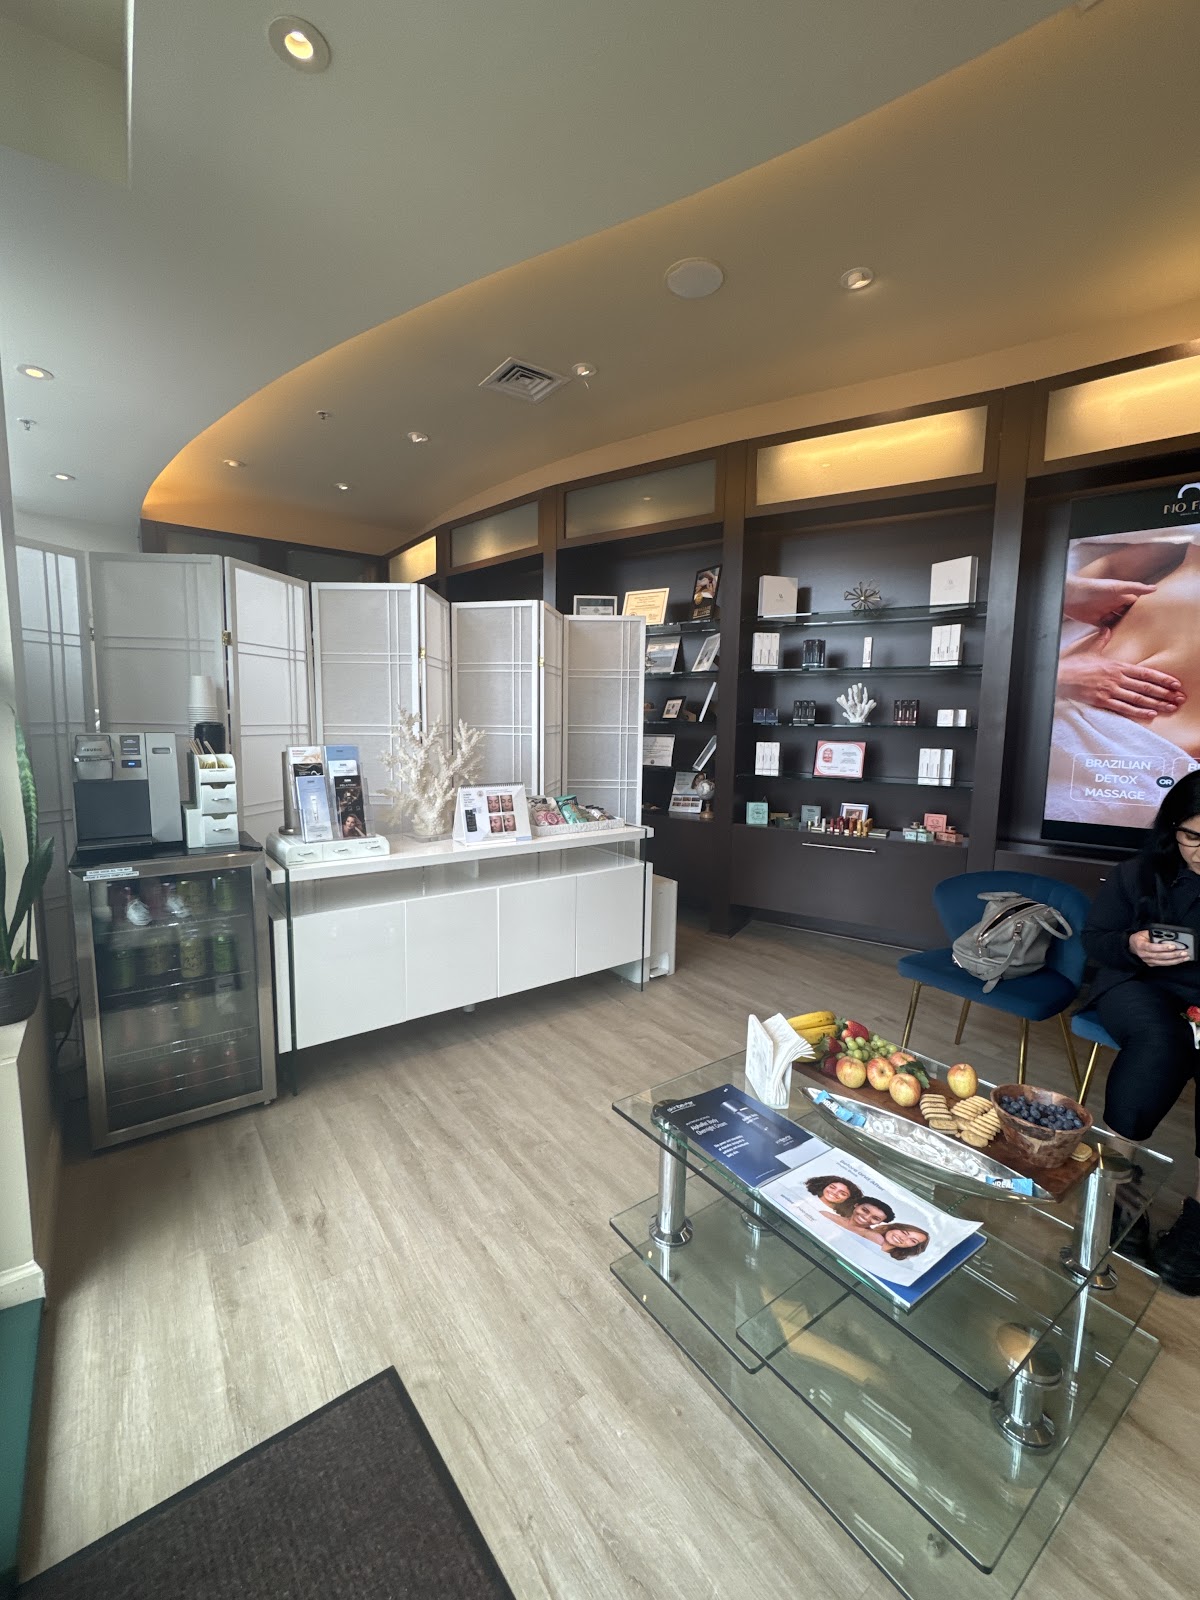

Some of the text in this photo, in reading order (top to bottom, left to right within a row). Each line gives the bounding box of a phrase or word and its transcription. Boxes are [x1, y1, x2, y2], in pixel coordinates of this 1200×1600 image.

[1163, 502, 1187, 514] NO
[1191, 500, 1200, 511] F
[1085, 759, 1151, 770] BRAZILIAN
[1095, 773, 1138, 784] DETOX
[1084, 788, 1146, 800] MASSAGE
